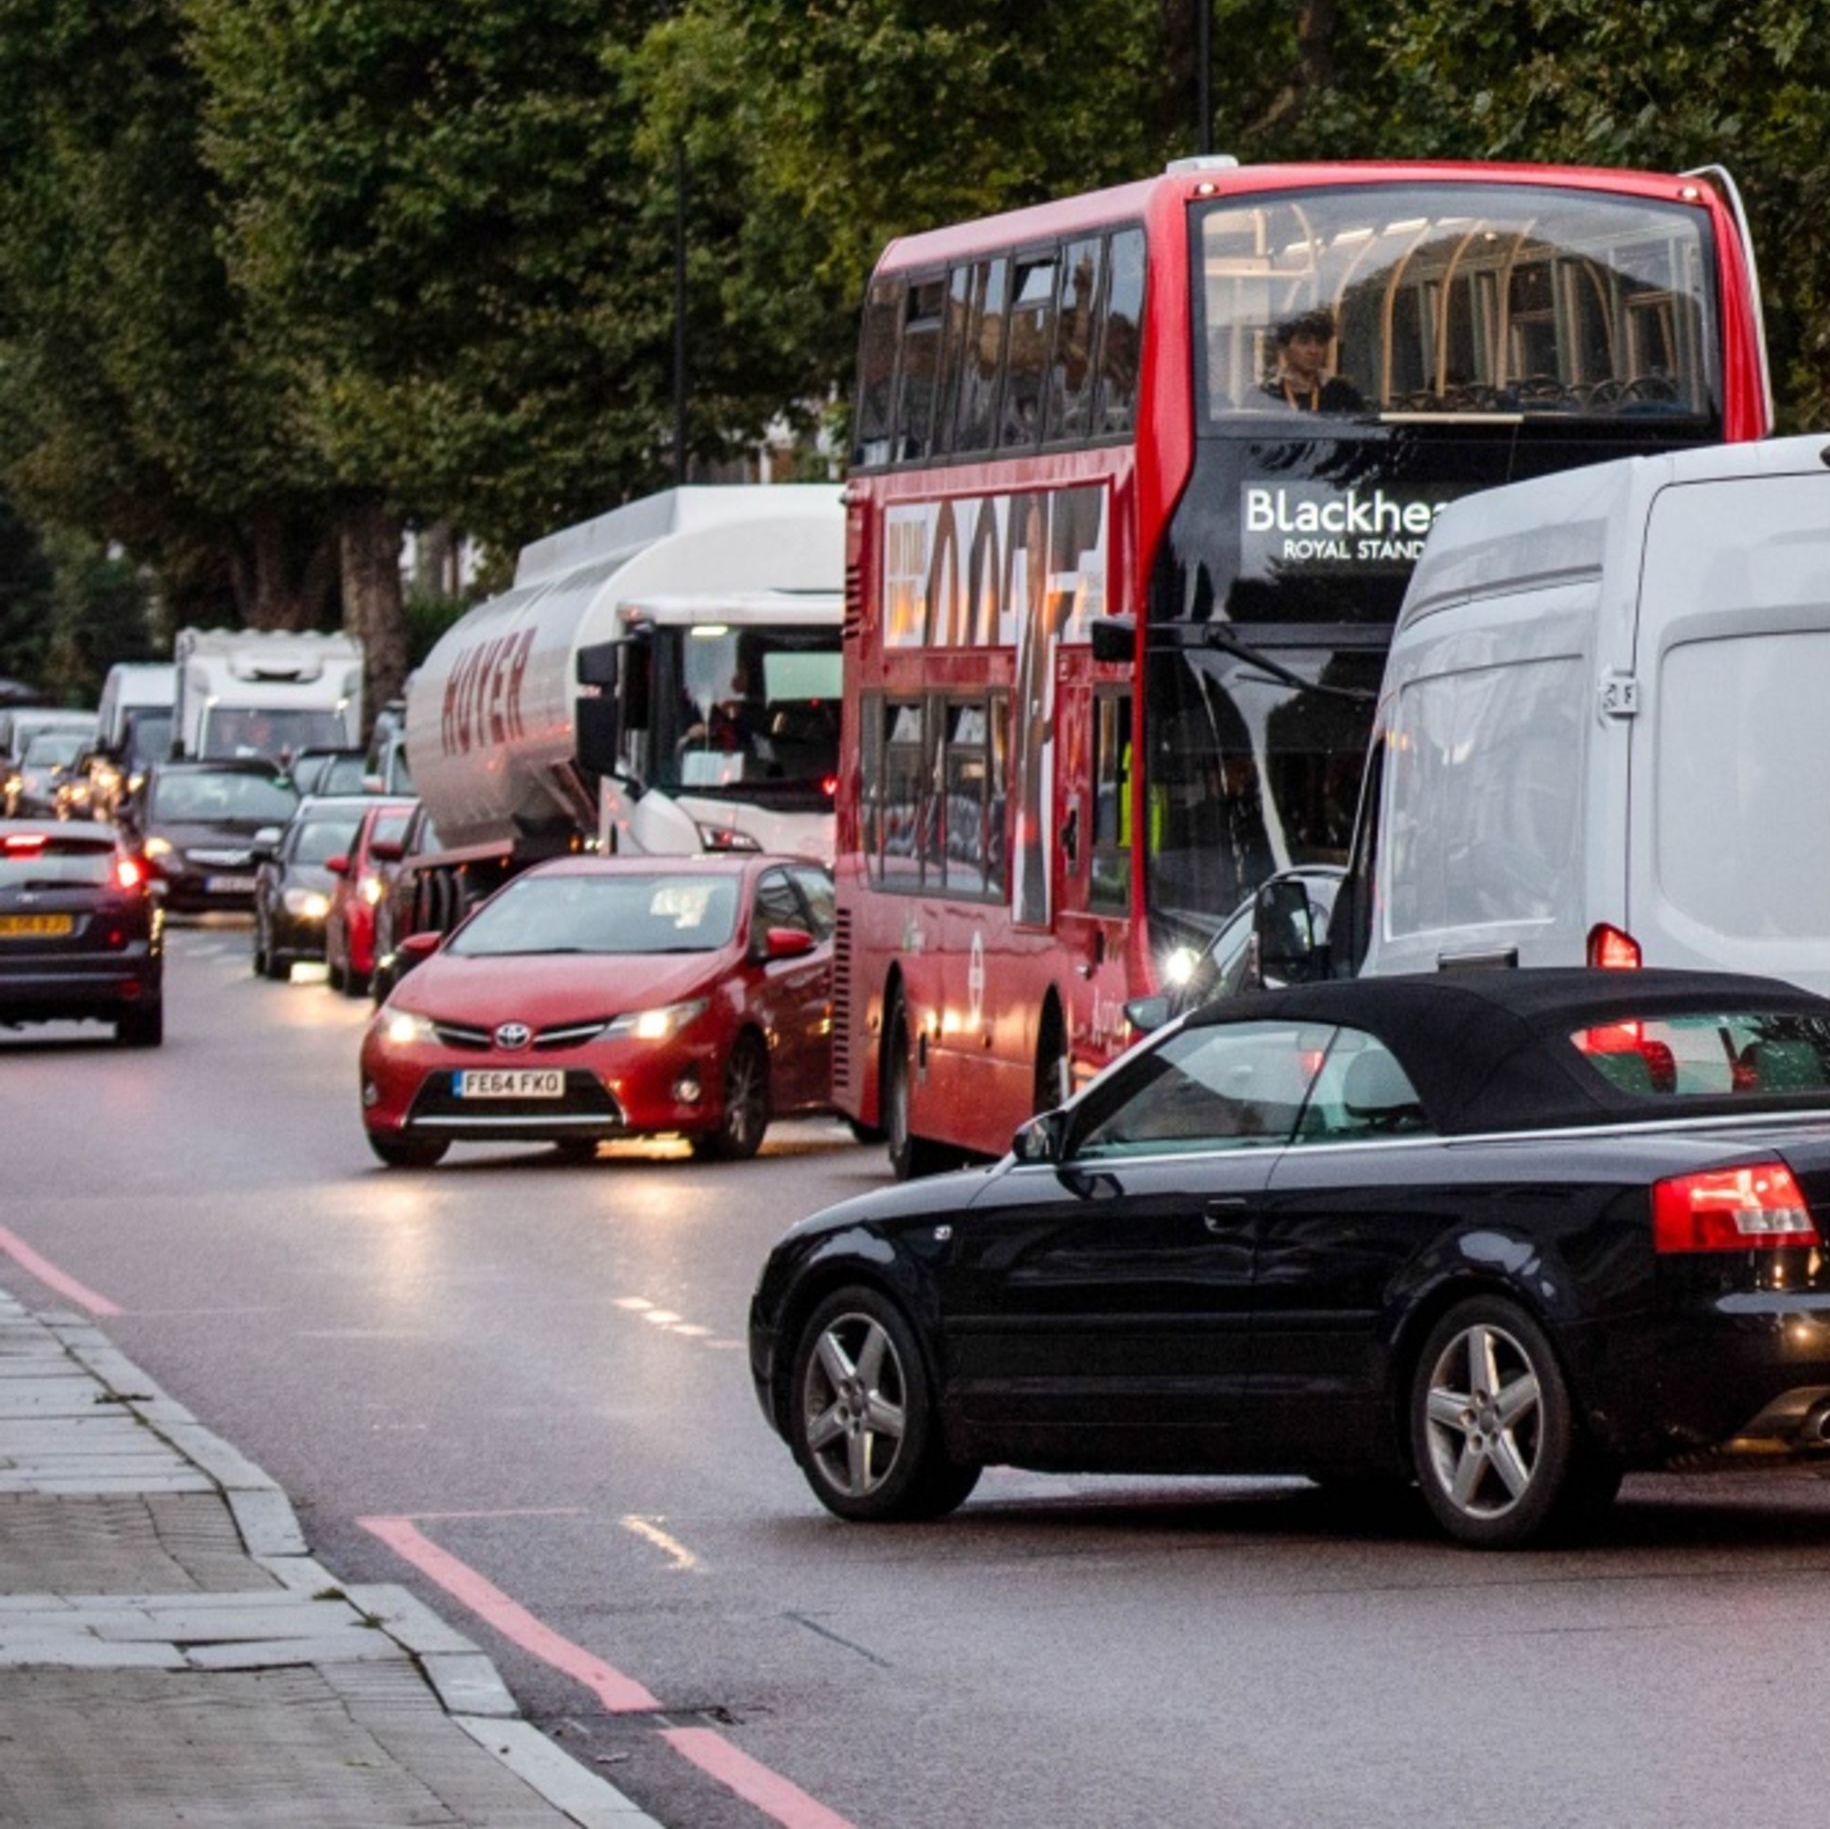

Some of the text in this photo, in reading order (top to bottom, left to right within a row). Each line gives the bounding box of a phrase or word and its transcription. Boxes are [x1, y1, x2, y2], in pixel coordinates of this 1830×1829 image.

[1284, 540, 1350, 559] ROYAL
[442, 627, 537, 755] HOYER
[466, 1073, 514, 1092] FE64
